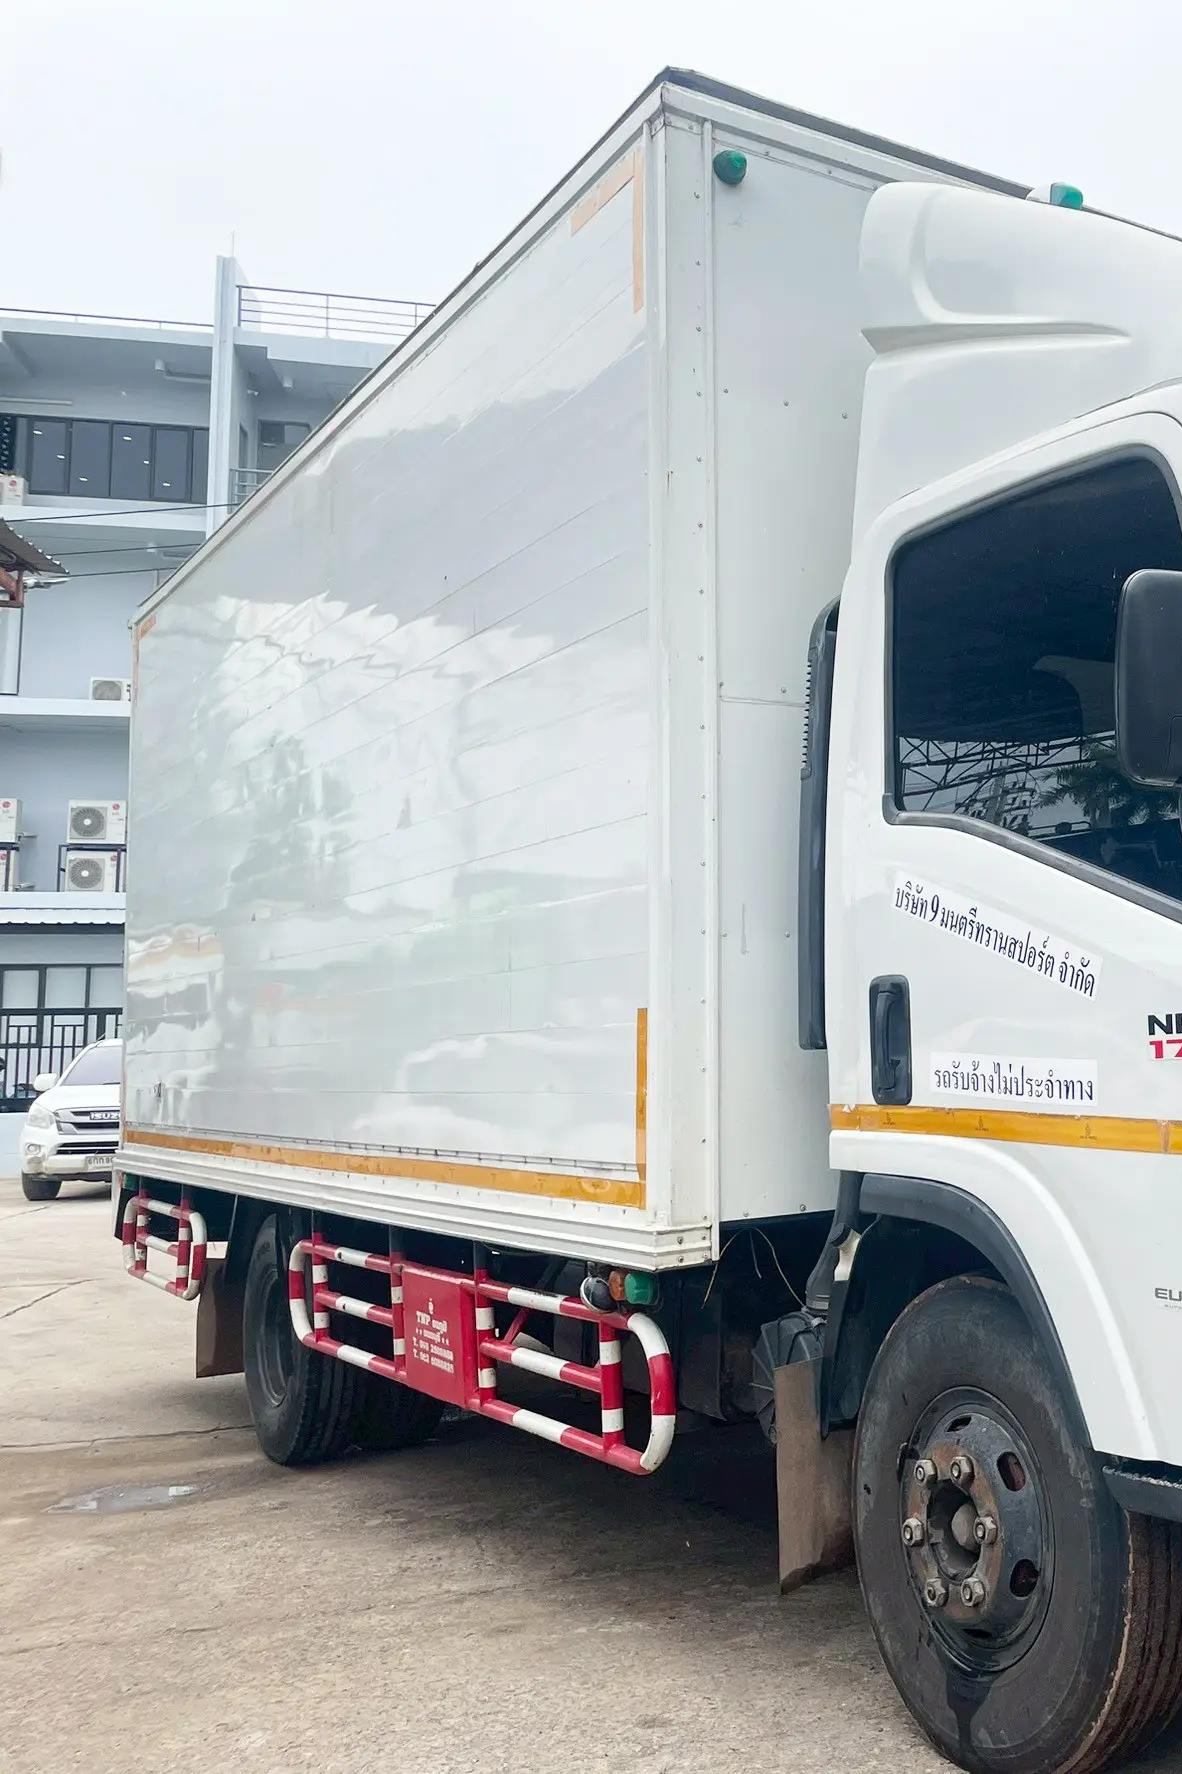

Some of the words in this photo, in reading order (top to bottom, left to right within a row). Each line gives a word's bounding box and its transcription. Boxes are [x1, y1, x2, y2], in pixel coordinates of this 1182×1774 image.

[895, 881, 928, 920] บริษัท
[940, 907, 1055, 978] มนตรีทรานสปอร์ต
[1058, 951, 1095, 997] จำกัด
[934, 1060, 1094, 1101] รถรับจ้างไม่ประจำทาง
[90, 1111, 120, 1120] ISUZ
